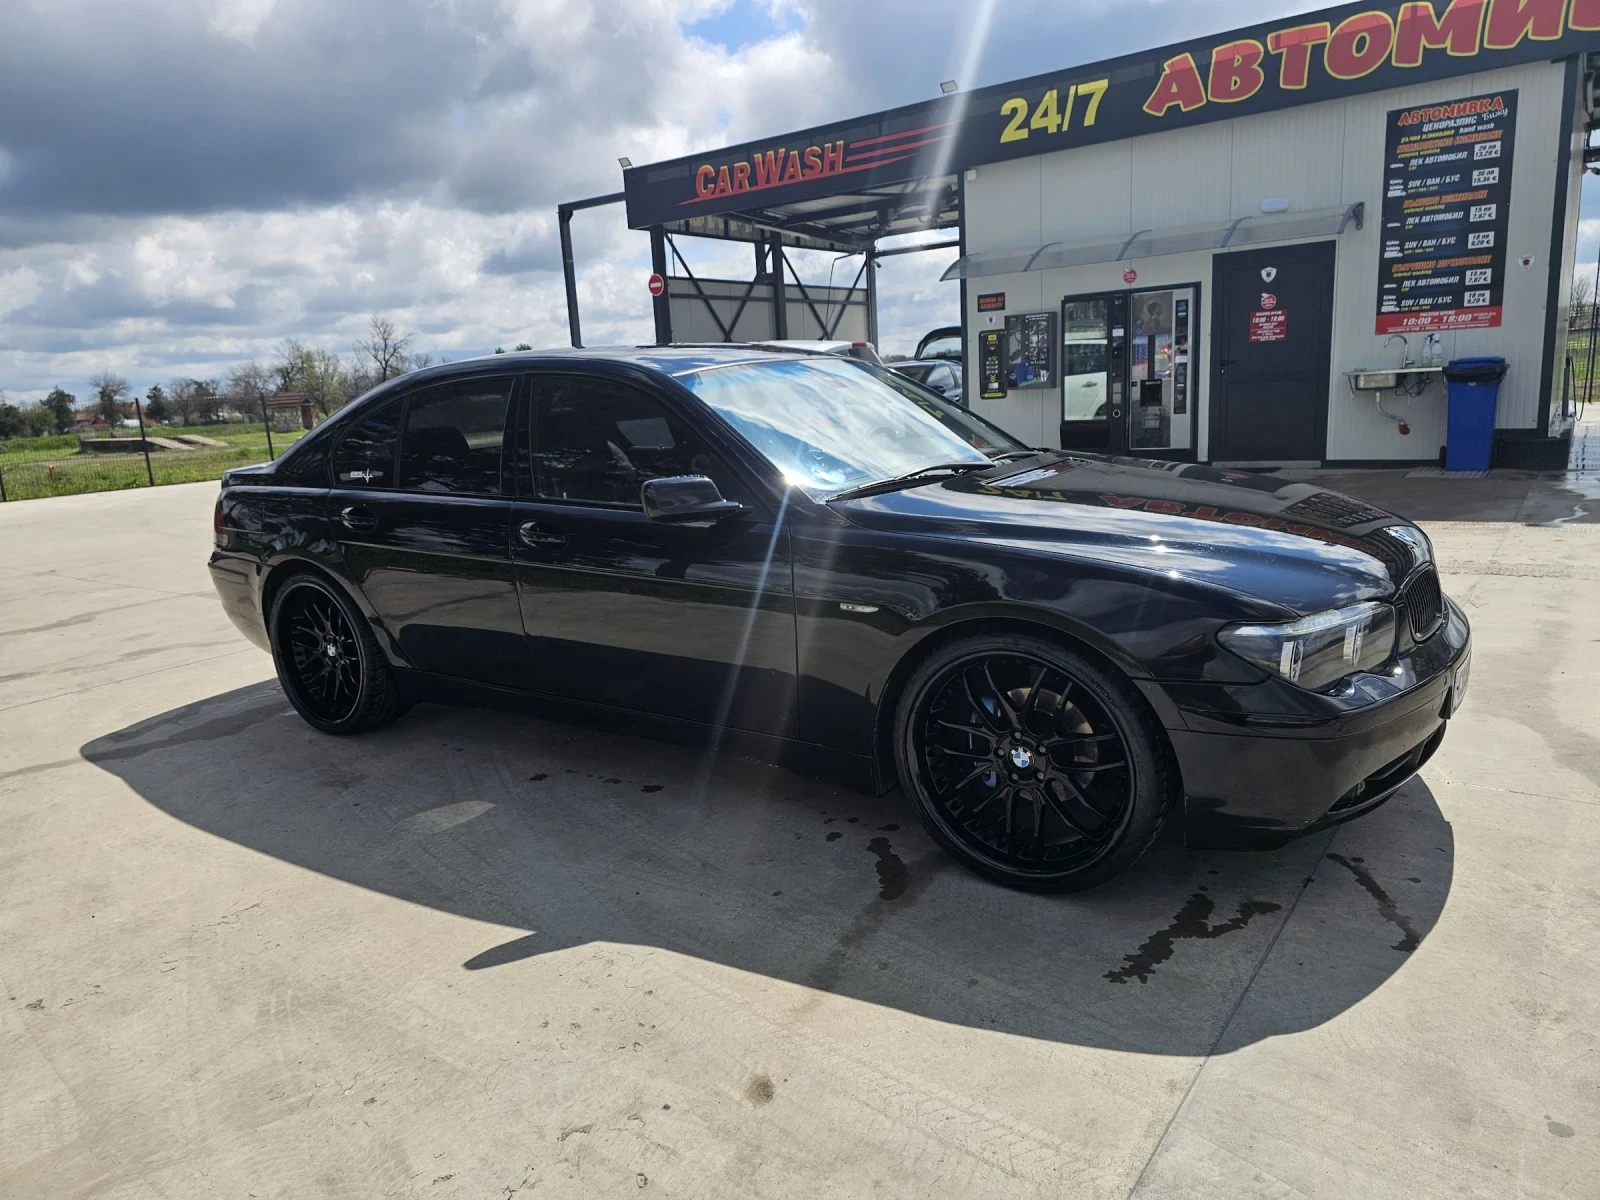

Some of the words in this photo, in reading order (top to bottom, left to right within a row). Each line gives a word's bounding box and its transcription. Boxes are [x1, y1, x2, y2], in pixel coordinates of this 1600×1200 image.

[1143, 0, 1600, 116] АВТОМИ
[1000, 79, 1108, 143] 24/7
[1398, 96, 1504, 126] АВТОМИВКА
[1422, 116, 1478, 132] ЦЕНОРАЗПИС
[1459, 124, 1476, 134] hand
[1477, 122, 1494, 132] wash
[1409, 158, 1422, 166] ЛЕК
[1424, 151, 1468, 164] АВТОМОБИЛ
[1408, 180, 1422, 188] SUV
[1445, 174, 1460, 184] БУС
[1406, 216, 1420, 224] ЛЕК
[1421, 211, 1464, 224] АВТОМОБИЛ
[1404, 240, 1418, 249] SUV
[1442, 236, 1456, 244] БУС
[1402, 278, 1416, 288] ЛЕК
[1417, 276, 1460, 286] АВТОМОБИЛ
[1401, 298, 1415, 306] SUV
[1402, 318, 1432, 326] 10:00
[1442, 314, 1472, 323] 18:00
